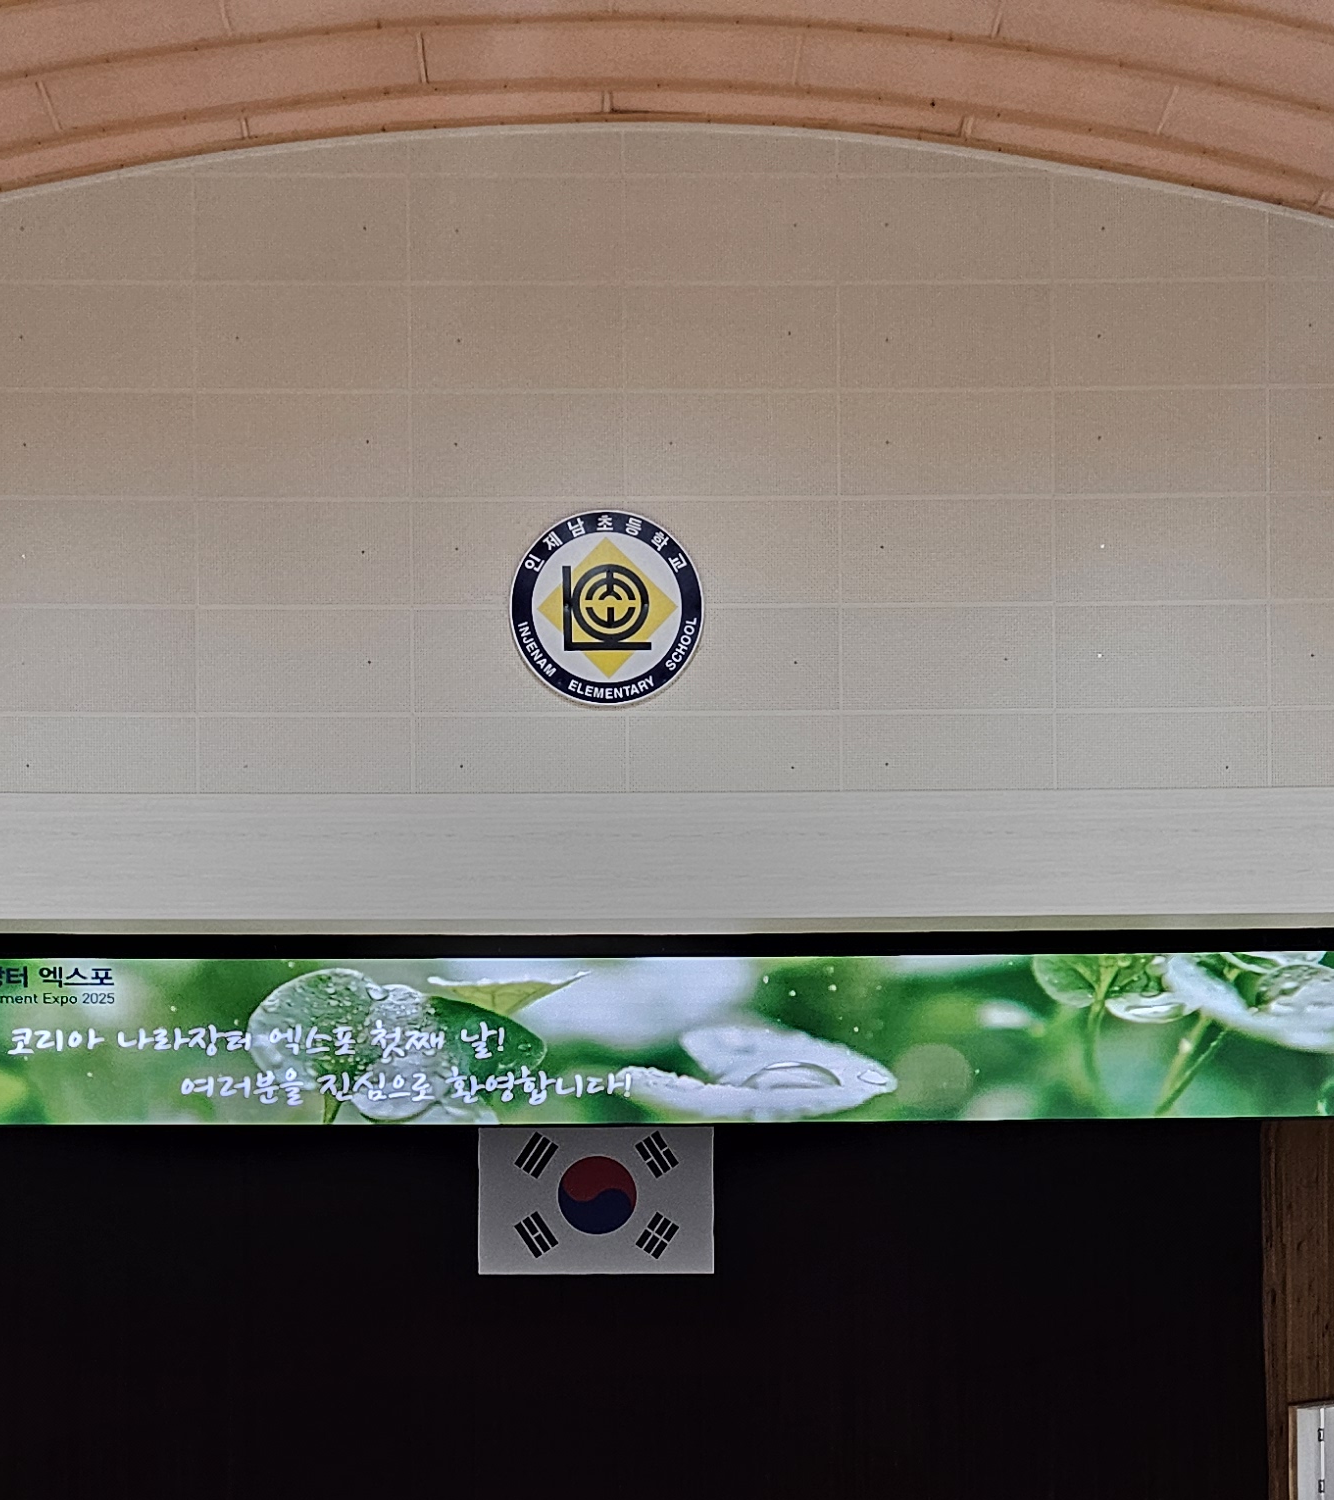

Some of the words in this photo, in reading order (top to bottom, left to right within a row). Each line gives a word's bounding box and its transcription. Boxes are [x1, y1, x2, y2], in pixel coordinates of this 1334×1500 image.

[524, 515, 688, 573] 인제남초등학교
[517, 621, 557, 678] INJENAM
[567, 675, 656, 700] ELEMENTARY
[665, 616, 698, 672] SCHOOL
[38, 966, 115, 988] 엑스포
[43, 992, 78, 1007] Expo
[82, 993, 115, 1004] 2025
[7, 1027, 105, 1055] 코리아
[117, 1024, 252, 1056] 나라장터
[269, 1024, 356, 1056] 엑스포
[369, 1019, 445, 1058] 첫째
[460, 1021, 506, 1060] 날!
[180, 1067, 304, 1106] 여러분을
[318, 1072, 436, 1102] 진심으로
[445, 1065, 633, 1106] 환영합니다!
